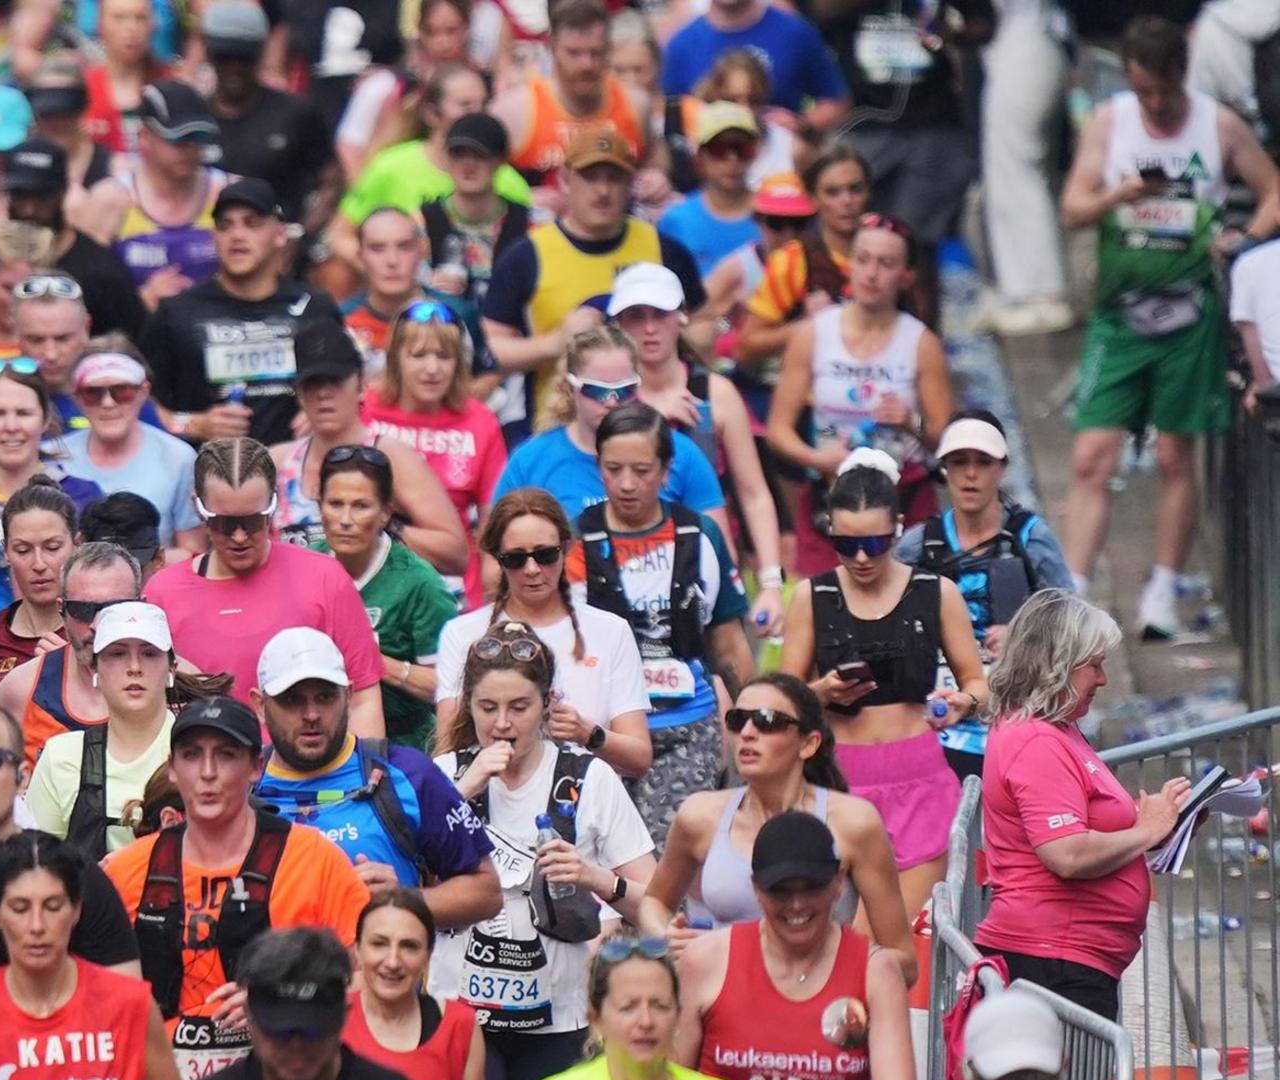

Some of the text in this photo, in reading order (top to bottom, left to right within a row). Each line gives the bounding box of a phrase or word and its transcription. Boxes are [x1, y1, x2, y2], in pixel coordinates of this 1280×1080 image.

[467, 939, 496, 963] tcs
[498, 949, 543, 960] CONSULTAN
[499, 942, 521, 952] TATA
[498, 957, 532, 967] SERVICES
[469, 974, 539, 1002] 63734
[176, 1022, 211, 1046] tcs
[490, 1018, 509, 1028] new
[17, 1032, 116, 1068] KATIE
[714, 1045, 868, 1075] Leukaemia Car
